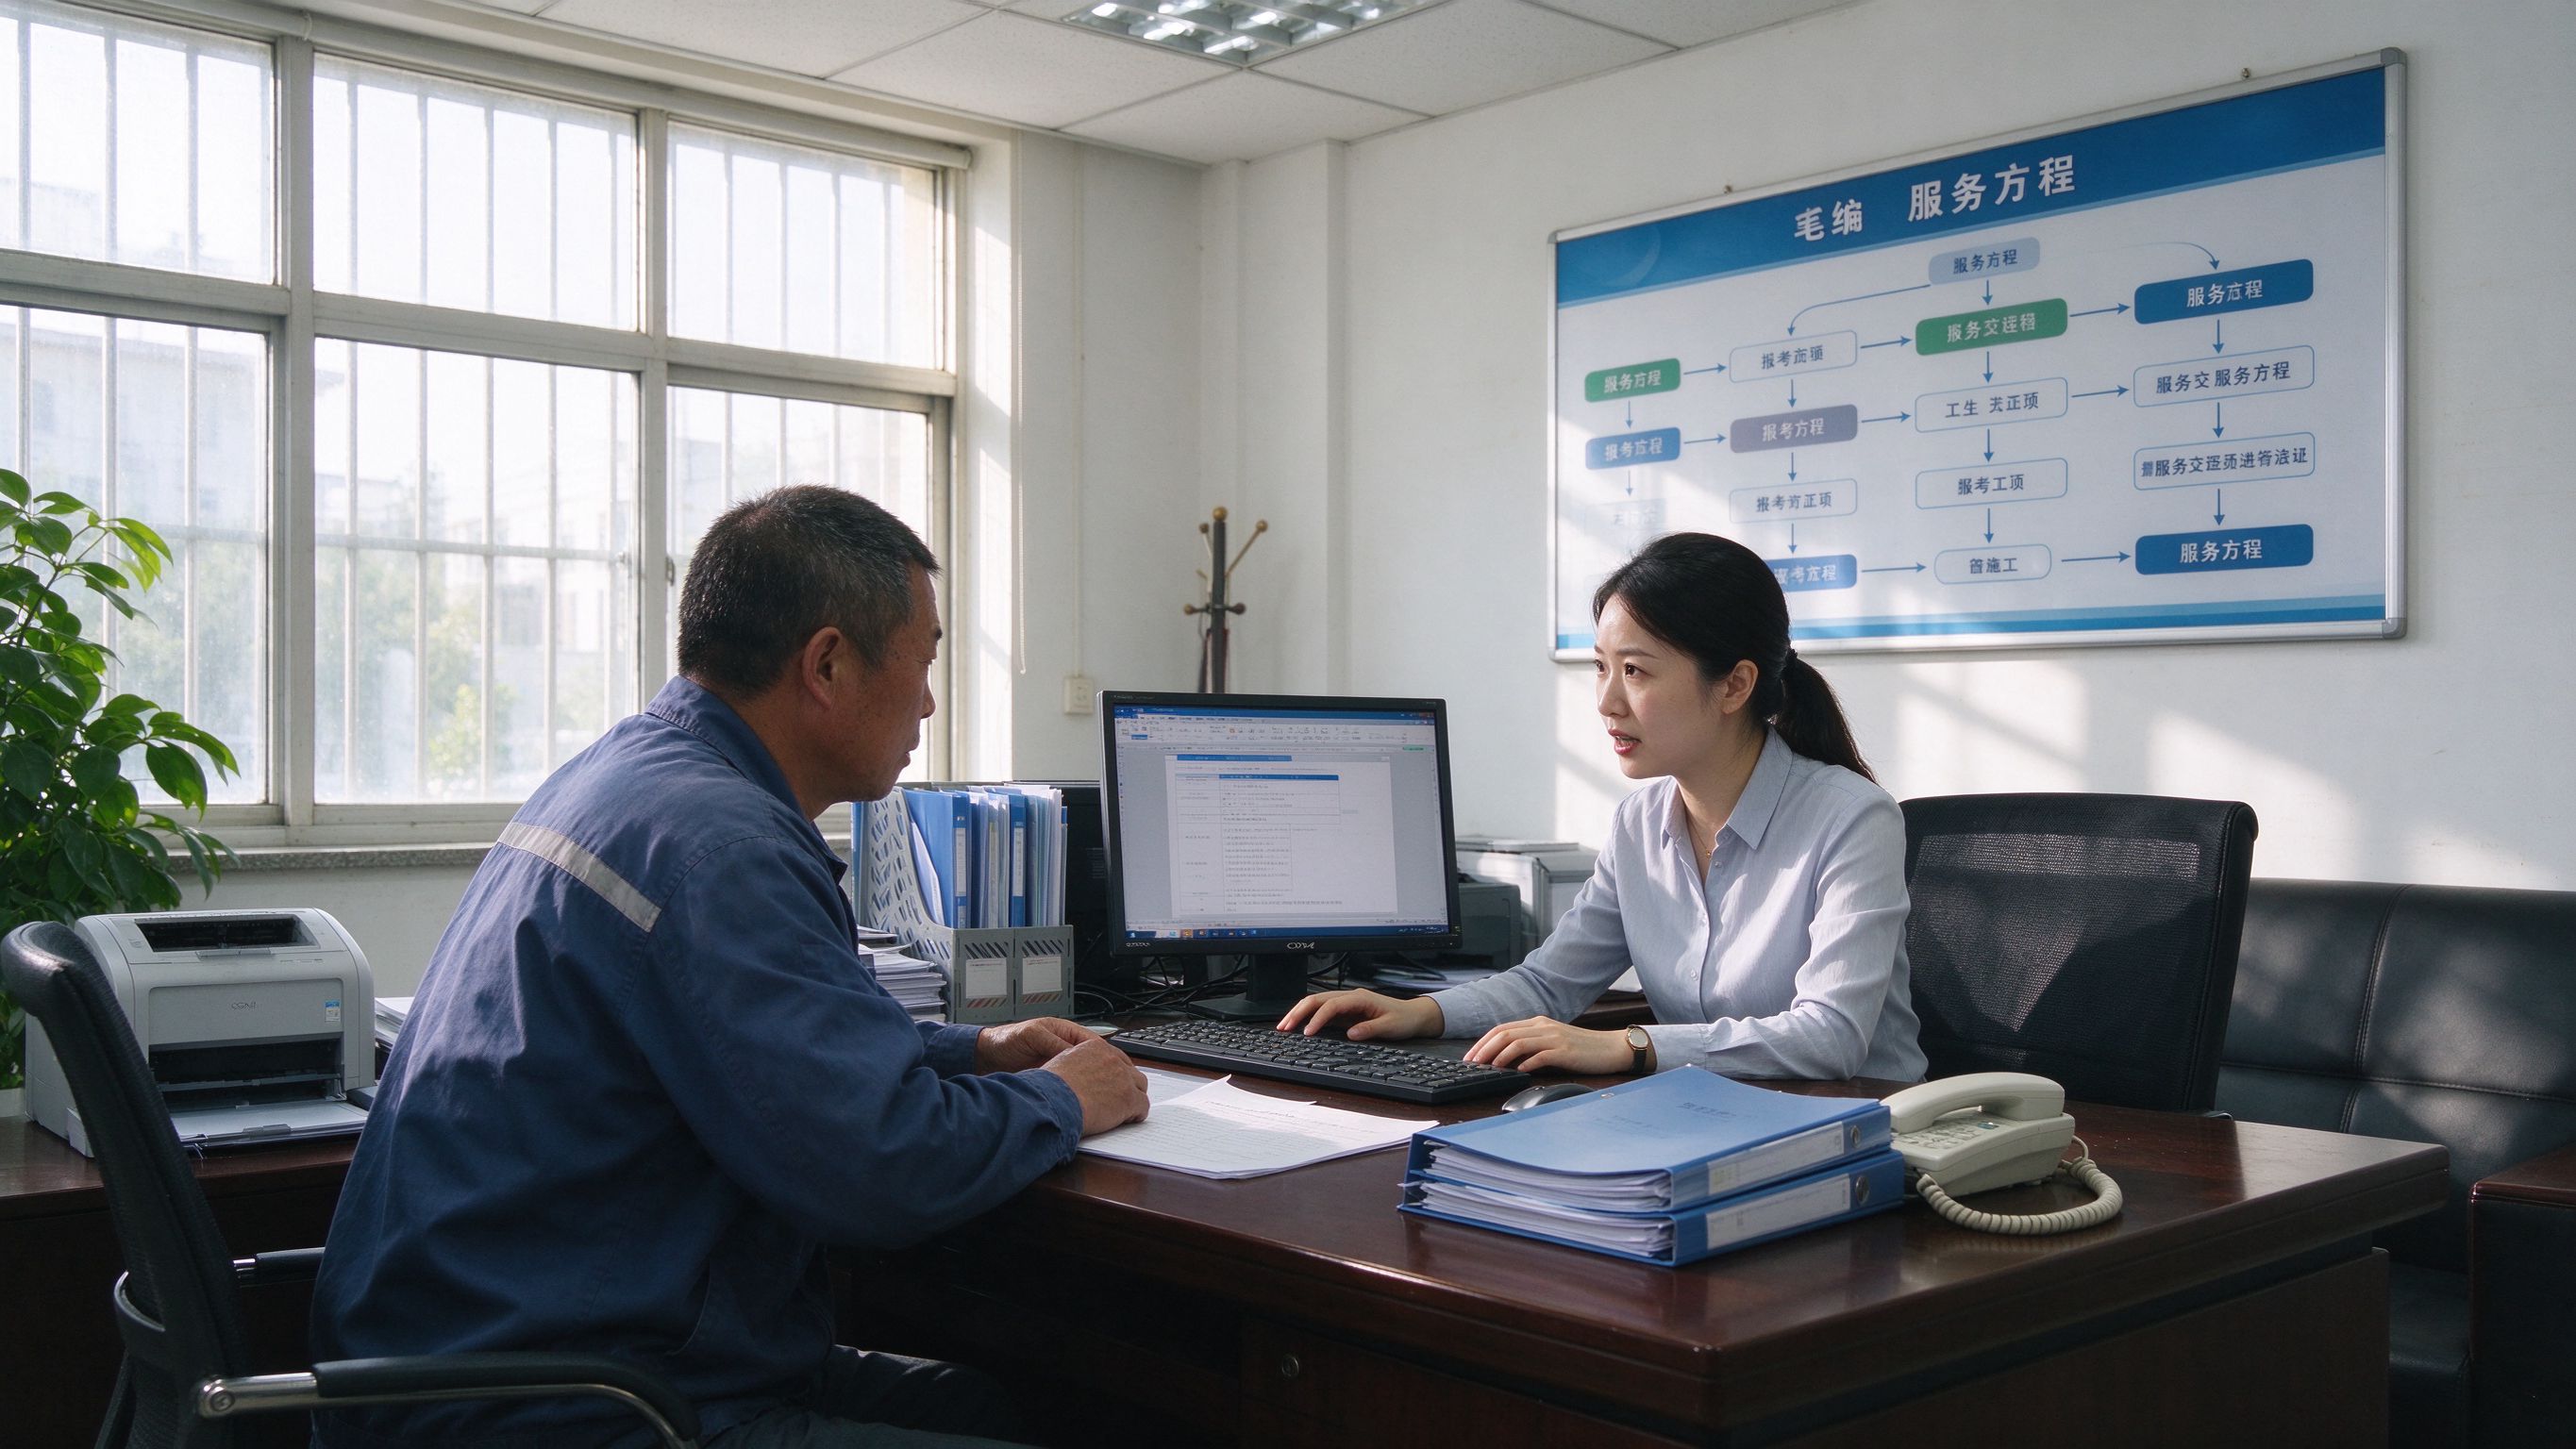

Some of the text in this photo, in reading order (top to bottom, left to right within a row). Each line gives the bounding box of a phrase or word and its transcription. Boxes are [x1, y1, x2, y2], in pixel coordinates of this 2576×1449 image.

[1908, 155, 2075, 222] 服务方程
[1953, 248, 2018, 275] 服务方程
[1945, 398, 1979, 419] 工生
[2180, 539, 2263, 564] 服务方程
